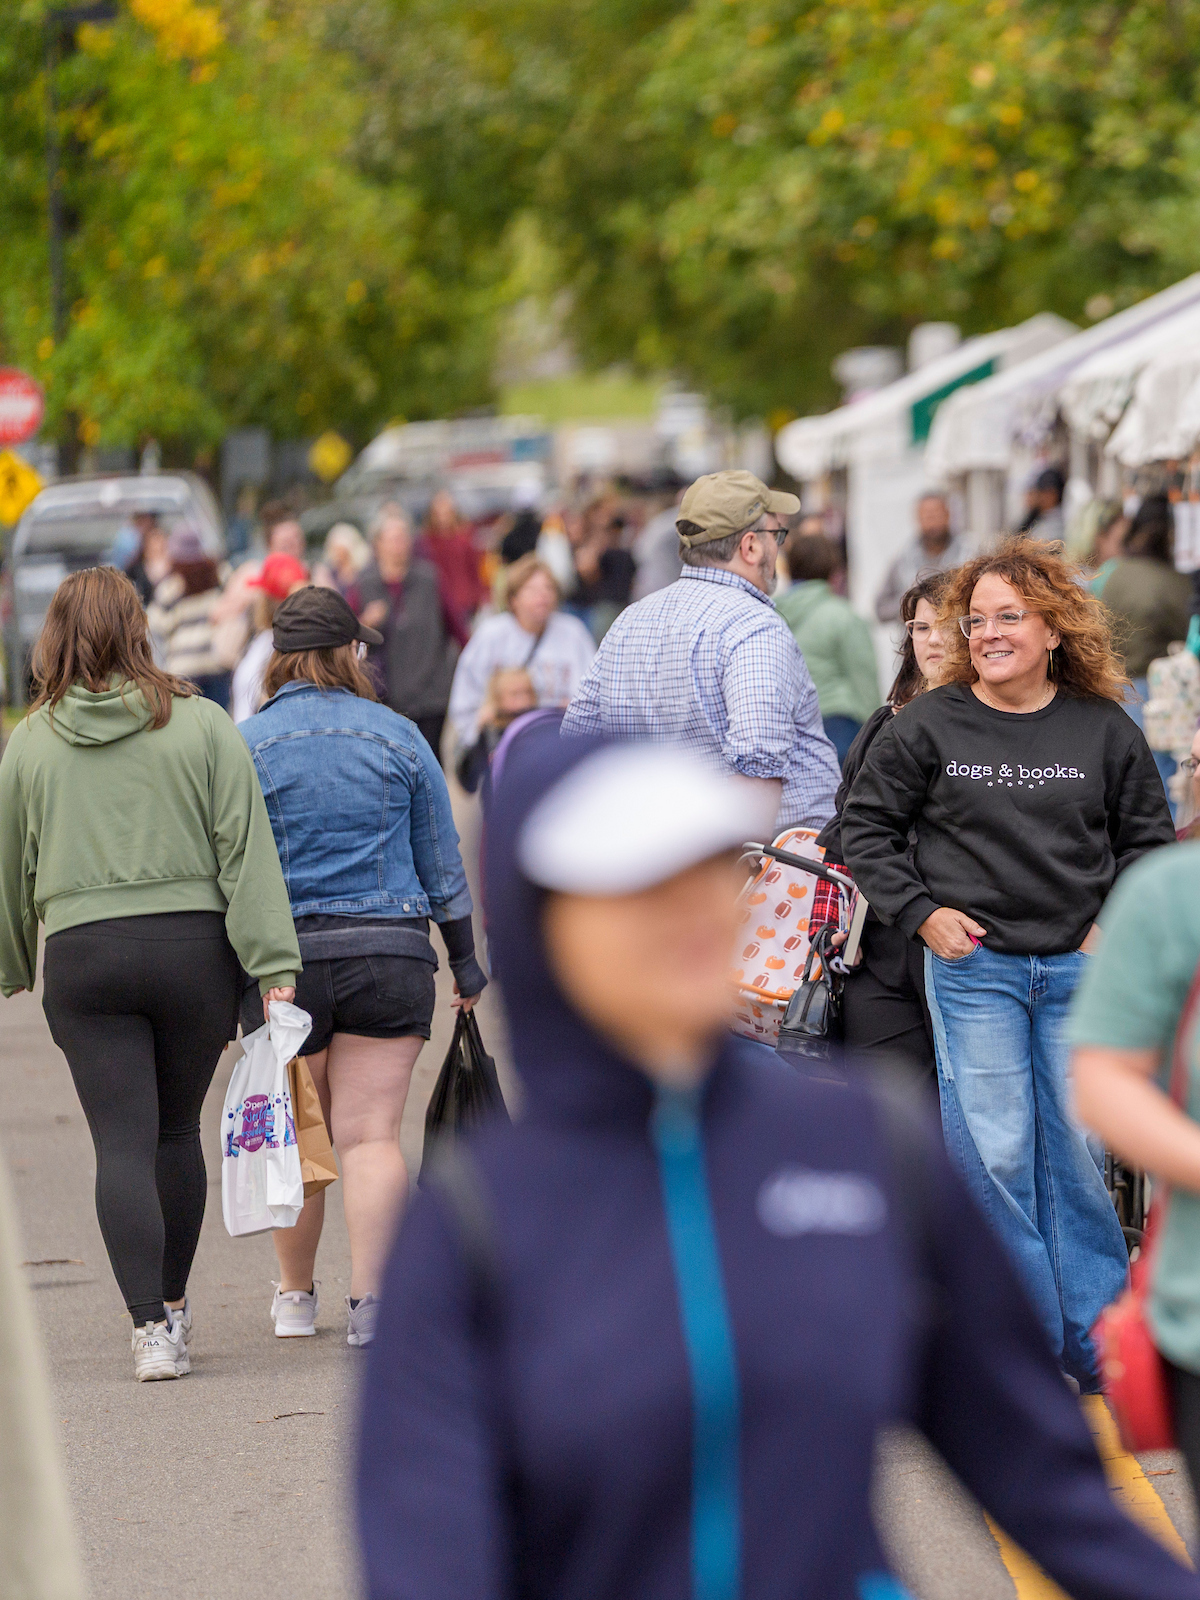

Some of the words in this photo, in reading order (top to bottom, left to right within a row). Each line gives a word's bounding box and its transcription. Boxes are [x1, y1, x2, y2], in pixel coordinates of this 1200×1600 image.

[945, 760, 993, 780] dogs
[998, 763, 1013, 778] &
[1017, 763, 1086, 779] books.
[245, 1100, 264, 1111] Open
[142, 1340, 160, 1348] FILA
